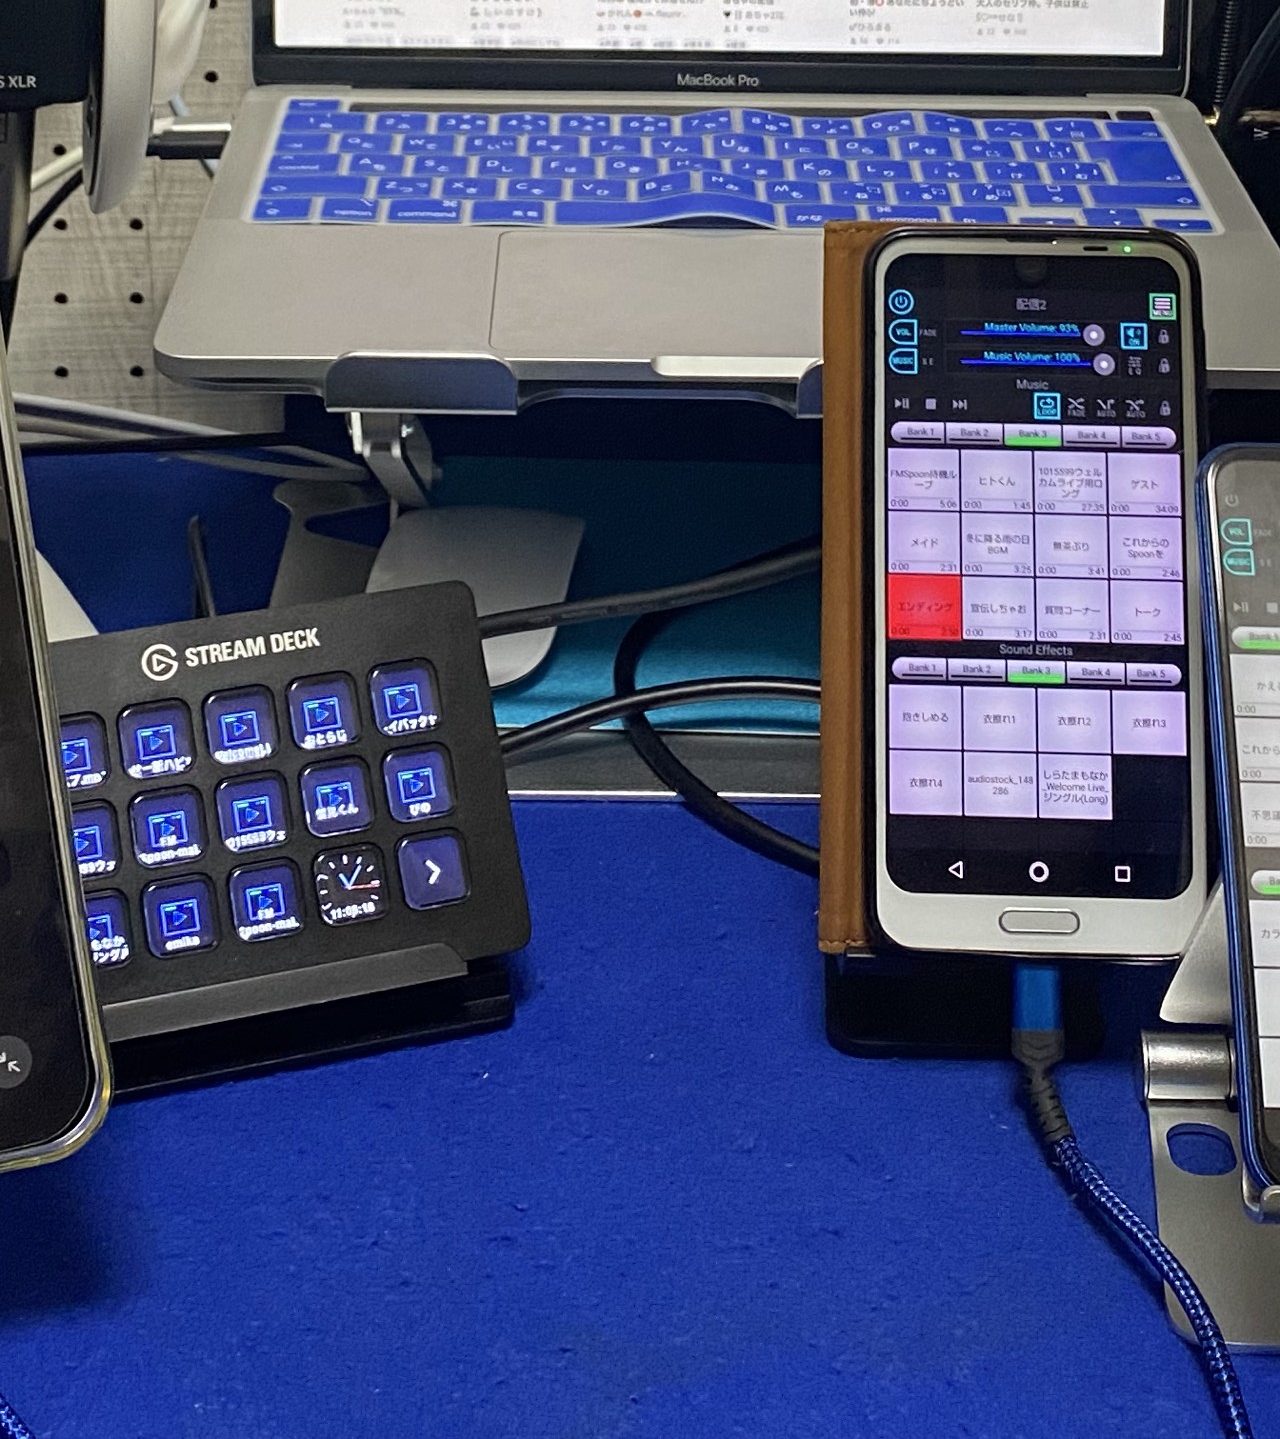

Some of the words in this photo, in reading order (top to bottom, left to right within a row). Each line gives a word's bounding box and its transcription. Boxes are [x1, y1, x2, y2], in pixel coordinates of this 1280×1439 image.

[8, 75, 37, 89] XLR
[677, 73, 735, 86] MacBook
[738, 75, 759, 86] Pro
[984, 323, 1016, 332] Master
[984, 351, 1013, 361] Music
[1016, 379, 1049, 390] Music
[910, 537, 938, 549] メイド
[898, 602, 953, 613] エンディング
[1134, 607, 1161, 617] トーク
[185, 636, 266, 668] STREAM
[270, 627, 321, 650] DECK
[999, 644, 1033, 655] Sound
[1036, 645, 1073, 656] Effects
